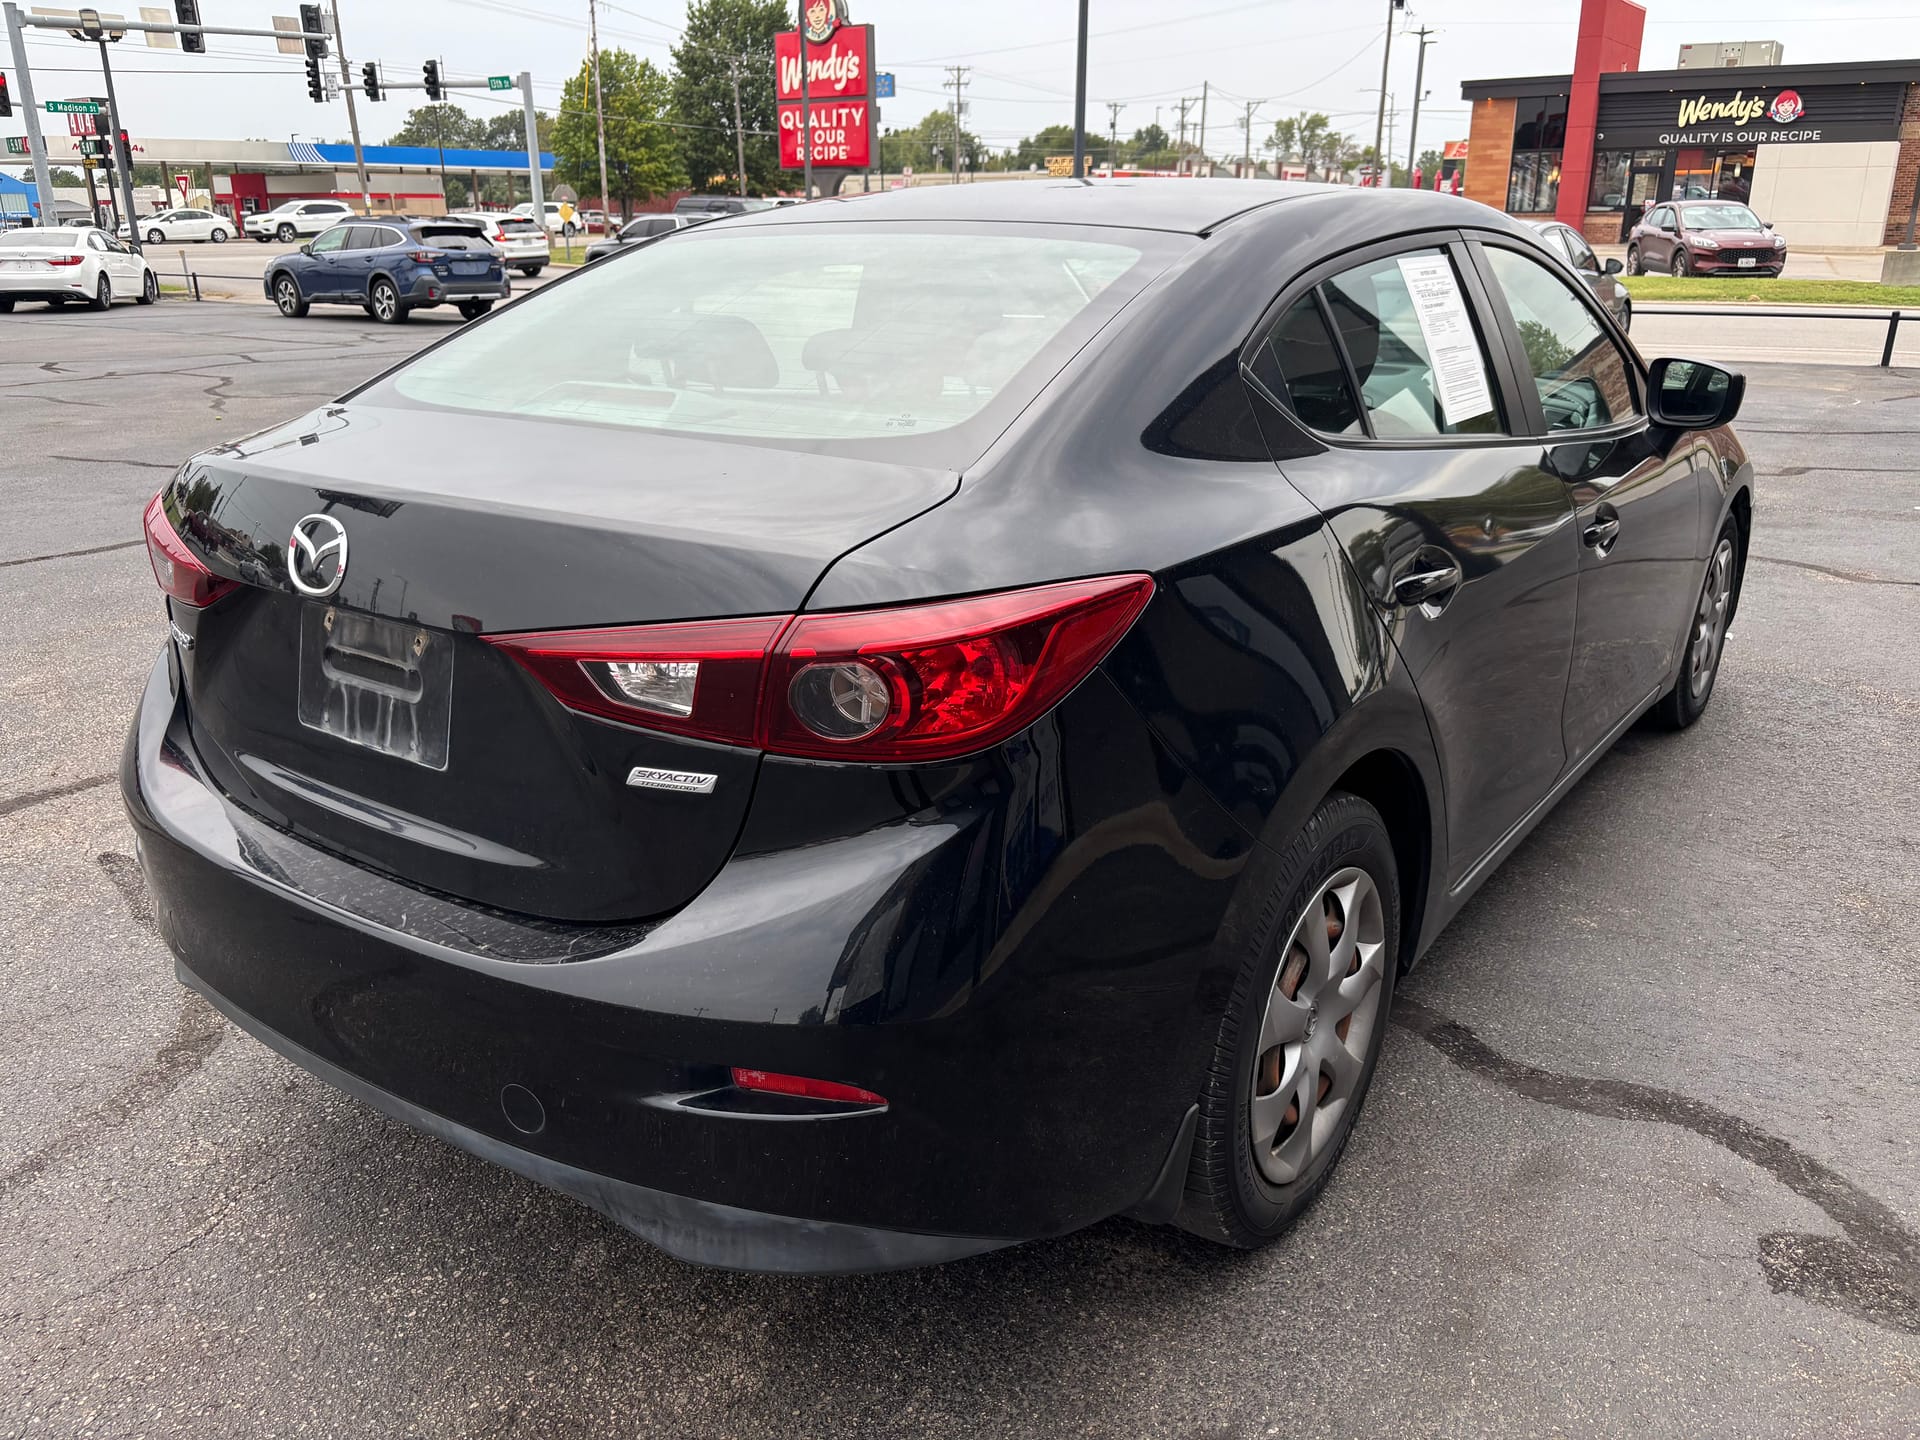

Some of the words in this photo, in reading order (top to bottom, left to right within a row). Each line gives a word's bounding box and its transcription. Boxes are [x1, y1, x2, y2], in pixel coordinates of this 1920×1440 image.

[49, 103, 54, 111] S
[57, 103, 88, 113] Madison
[1678, 90, 1765, 127] Wendy's
[780, 107, 864, 130] QUALITY
[814, 129, 845, 144] OUR
[1658, 132, 1719, 145] QUALITY
[1721, 132, 1734, 143] IS
[1736, 131, 1768, 143] OUR
[1770, 130, 1822, 142] RECIPE
[637, 770, 708, 784] SKYACTIV
[640, 781, 698, 792] TECHNOLOGY
